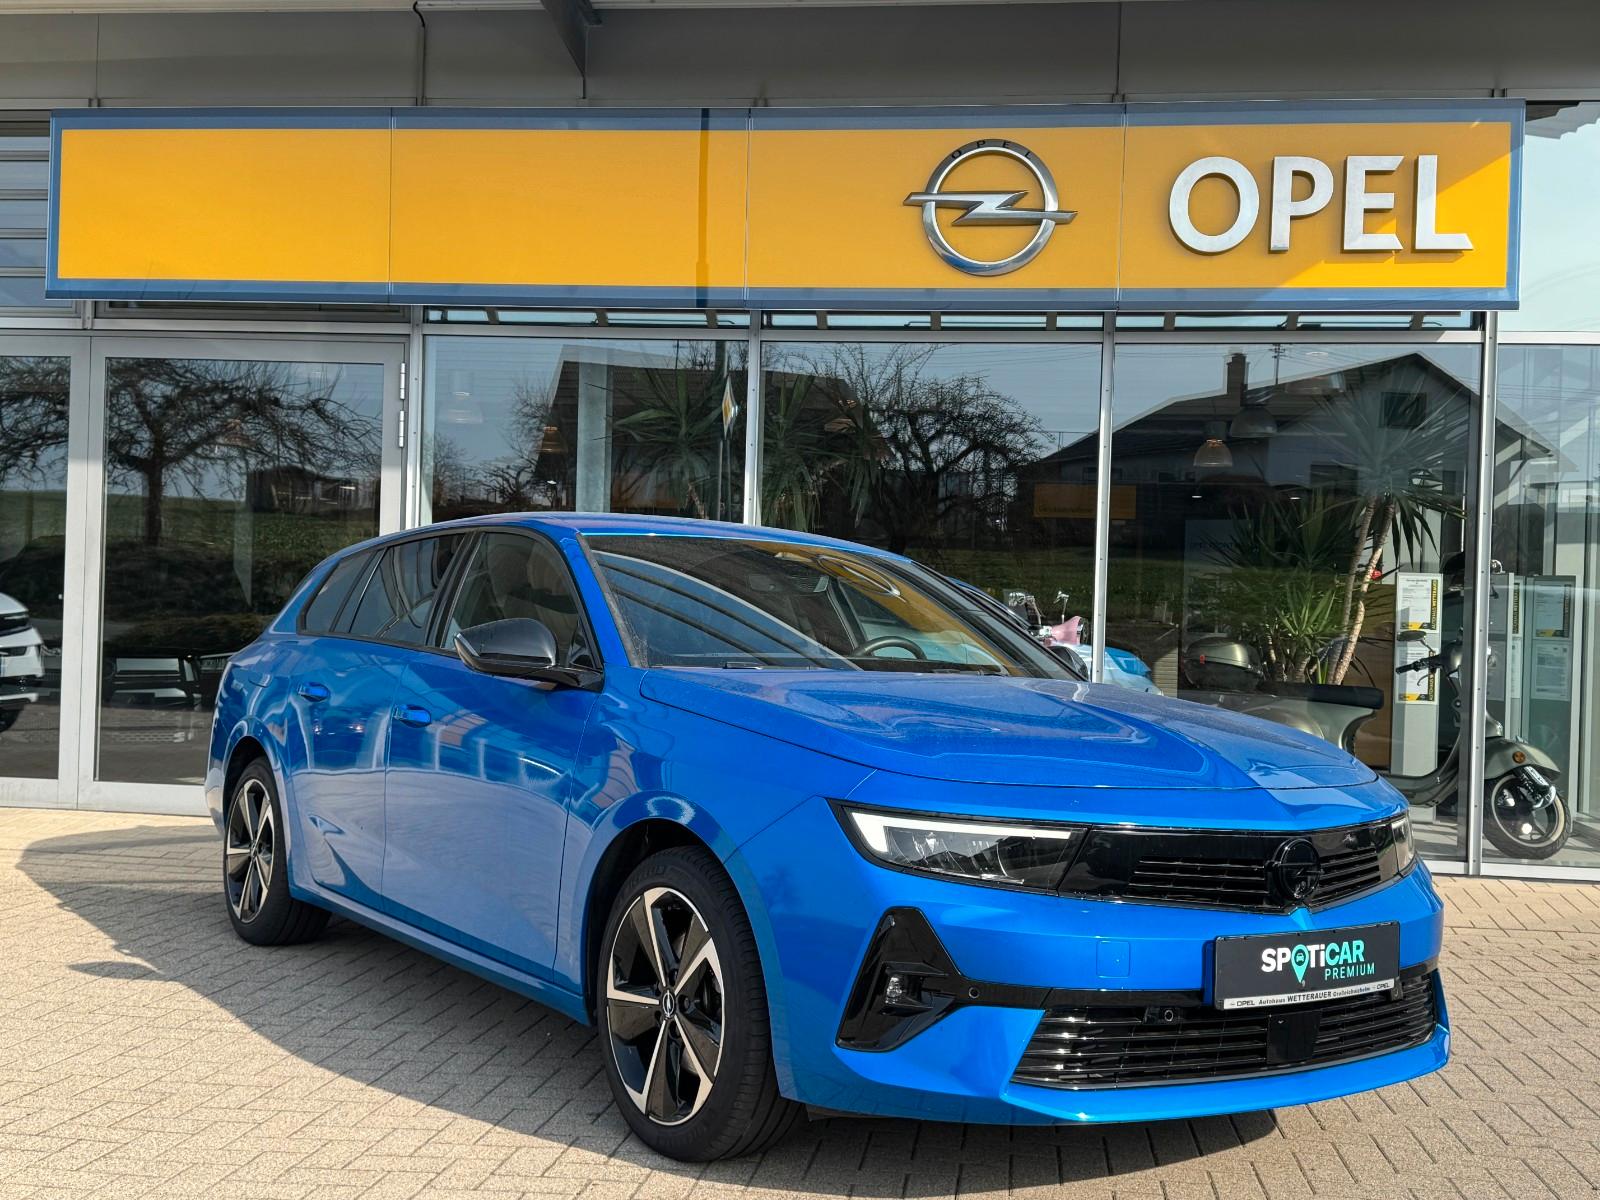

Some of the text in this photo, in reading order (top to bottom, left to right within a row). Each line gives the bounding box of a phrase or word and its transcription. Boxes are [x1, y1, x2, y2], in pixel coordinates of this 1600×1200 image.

[951, 139, 1033, 159] OPEL
[1168, 154, 1474, 254] OPEL
[1325, 962, 1375, 981] PREMIUM
[1287, 991, 1332, 1003] WETTERAUER
[1376, 982, 1390, 990] OPEL
